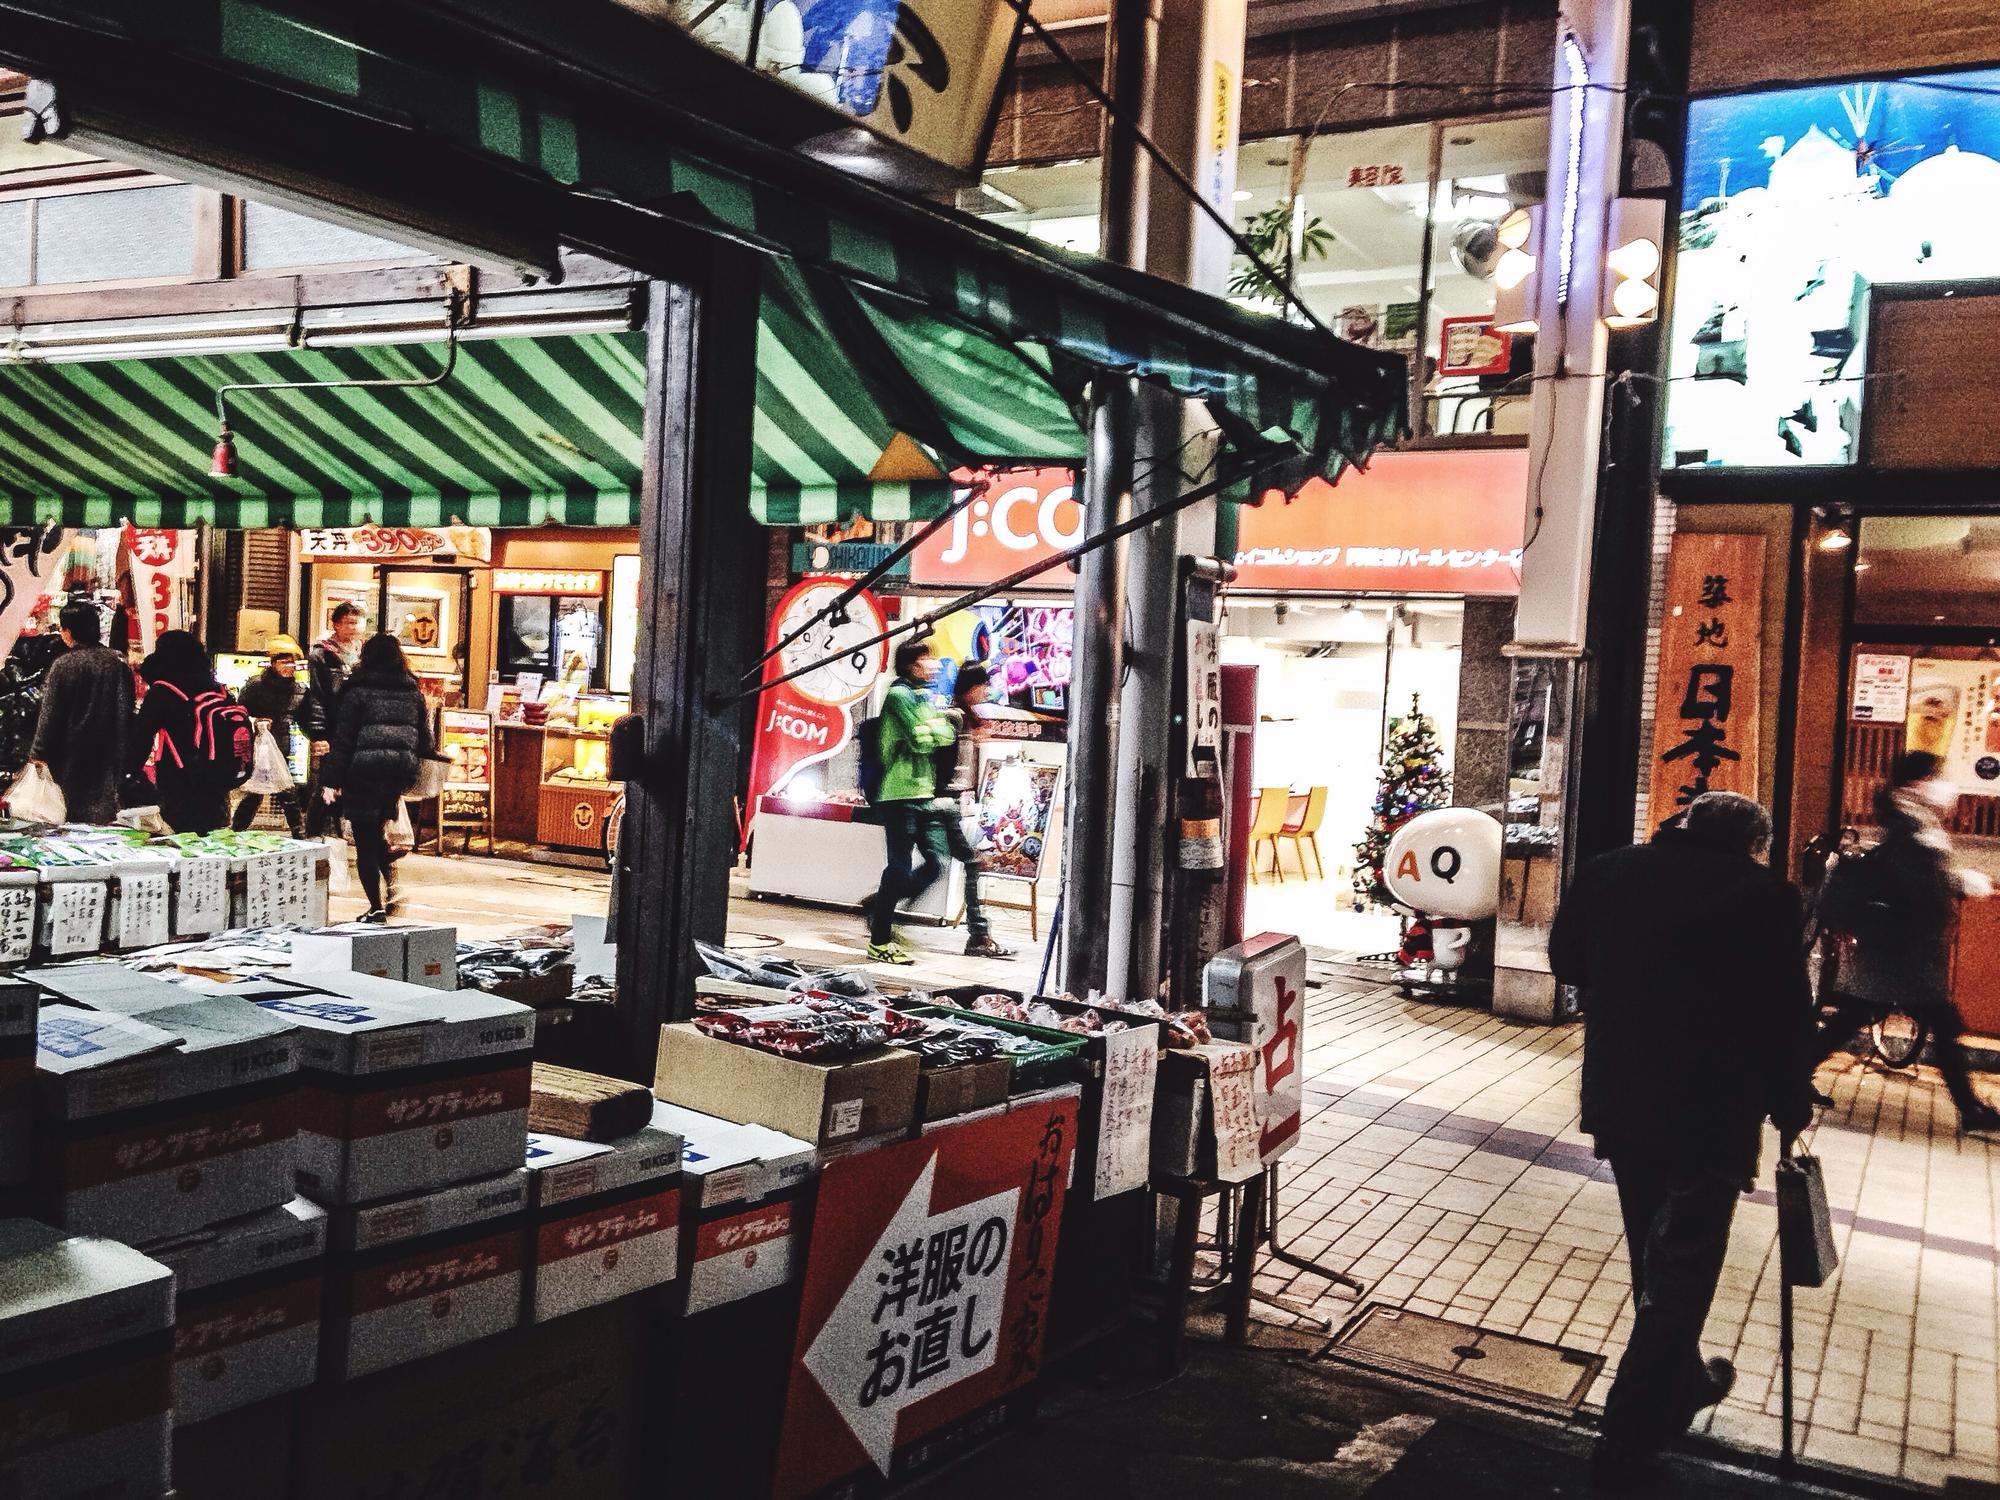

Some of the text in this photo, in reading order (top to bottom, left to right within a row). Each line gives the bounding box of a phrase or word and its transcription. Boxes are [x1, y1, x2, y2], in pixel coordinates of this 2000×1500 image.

[309, 529, 349, 551] 天丼
[361, 530, 423, 554] 390
[940, 485, 1085, 564] J:CO
[765, 709, 829, 746] J:COM
[871, 1216, 1008, 1323] 洋服の
[858, 1295, 993, 1409] お直し
